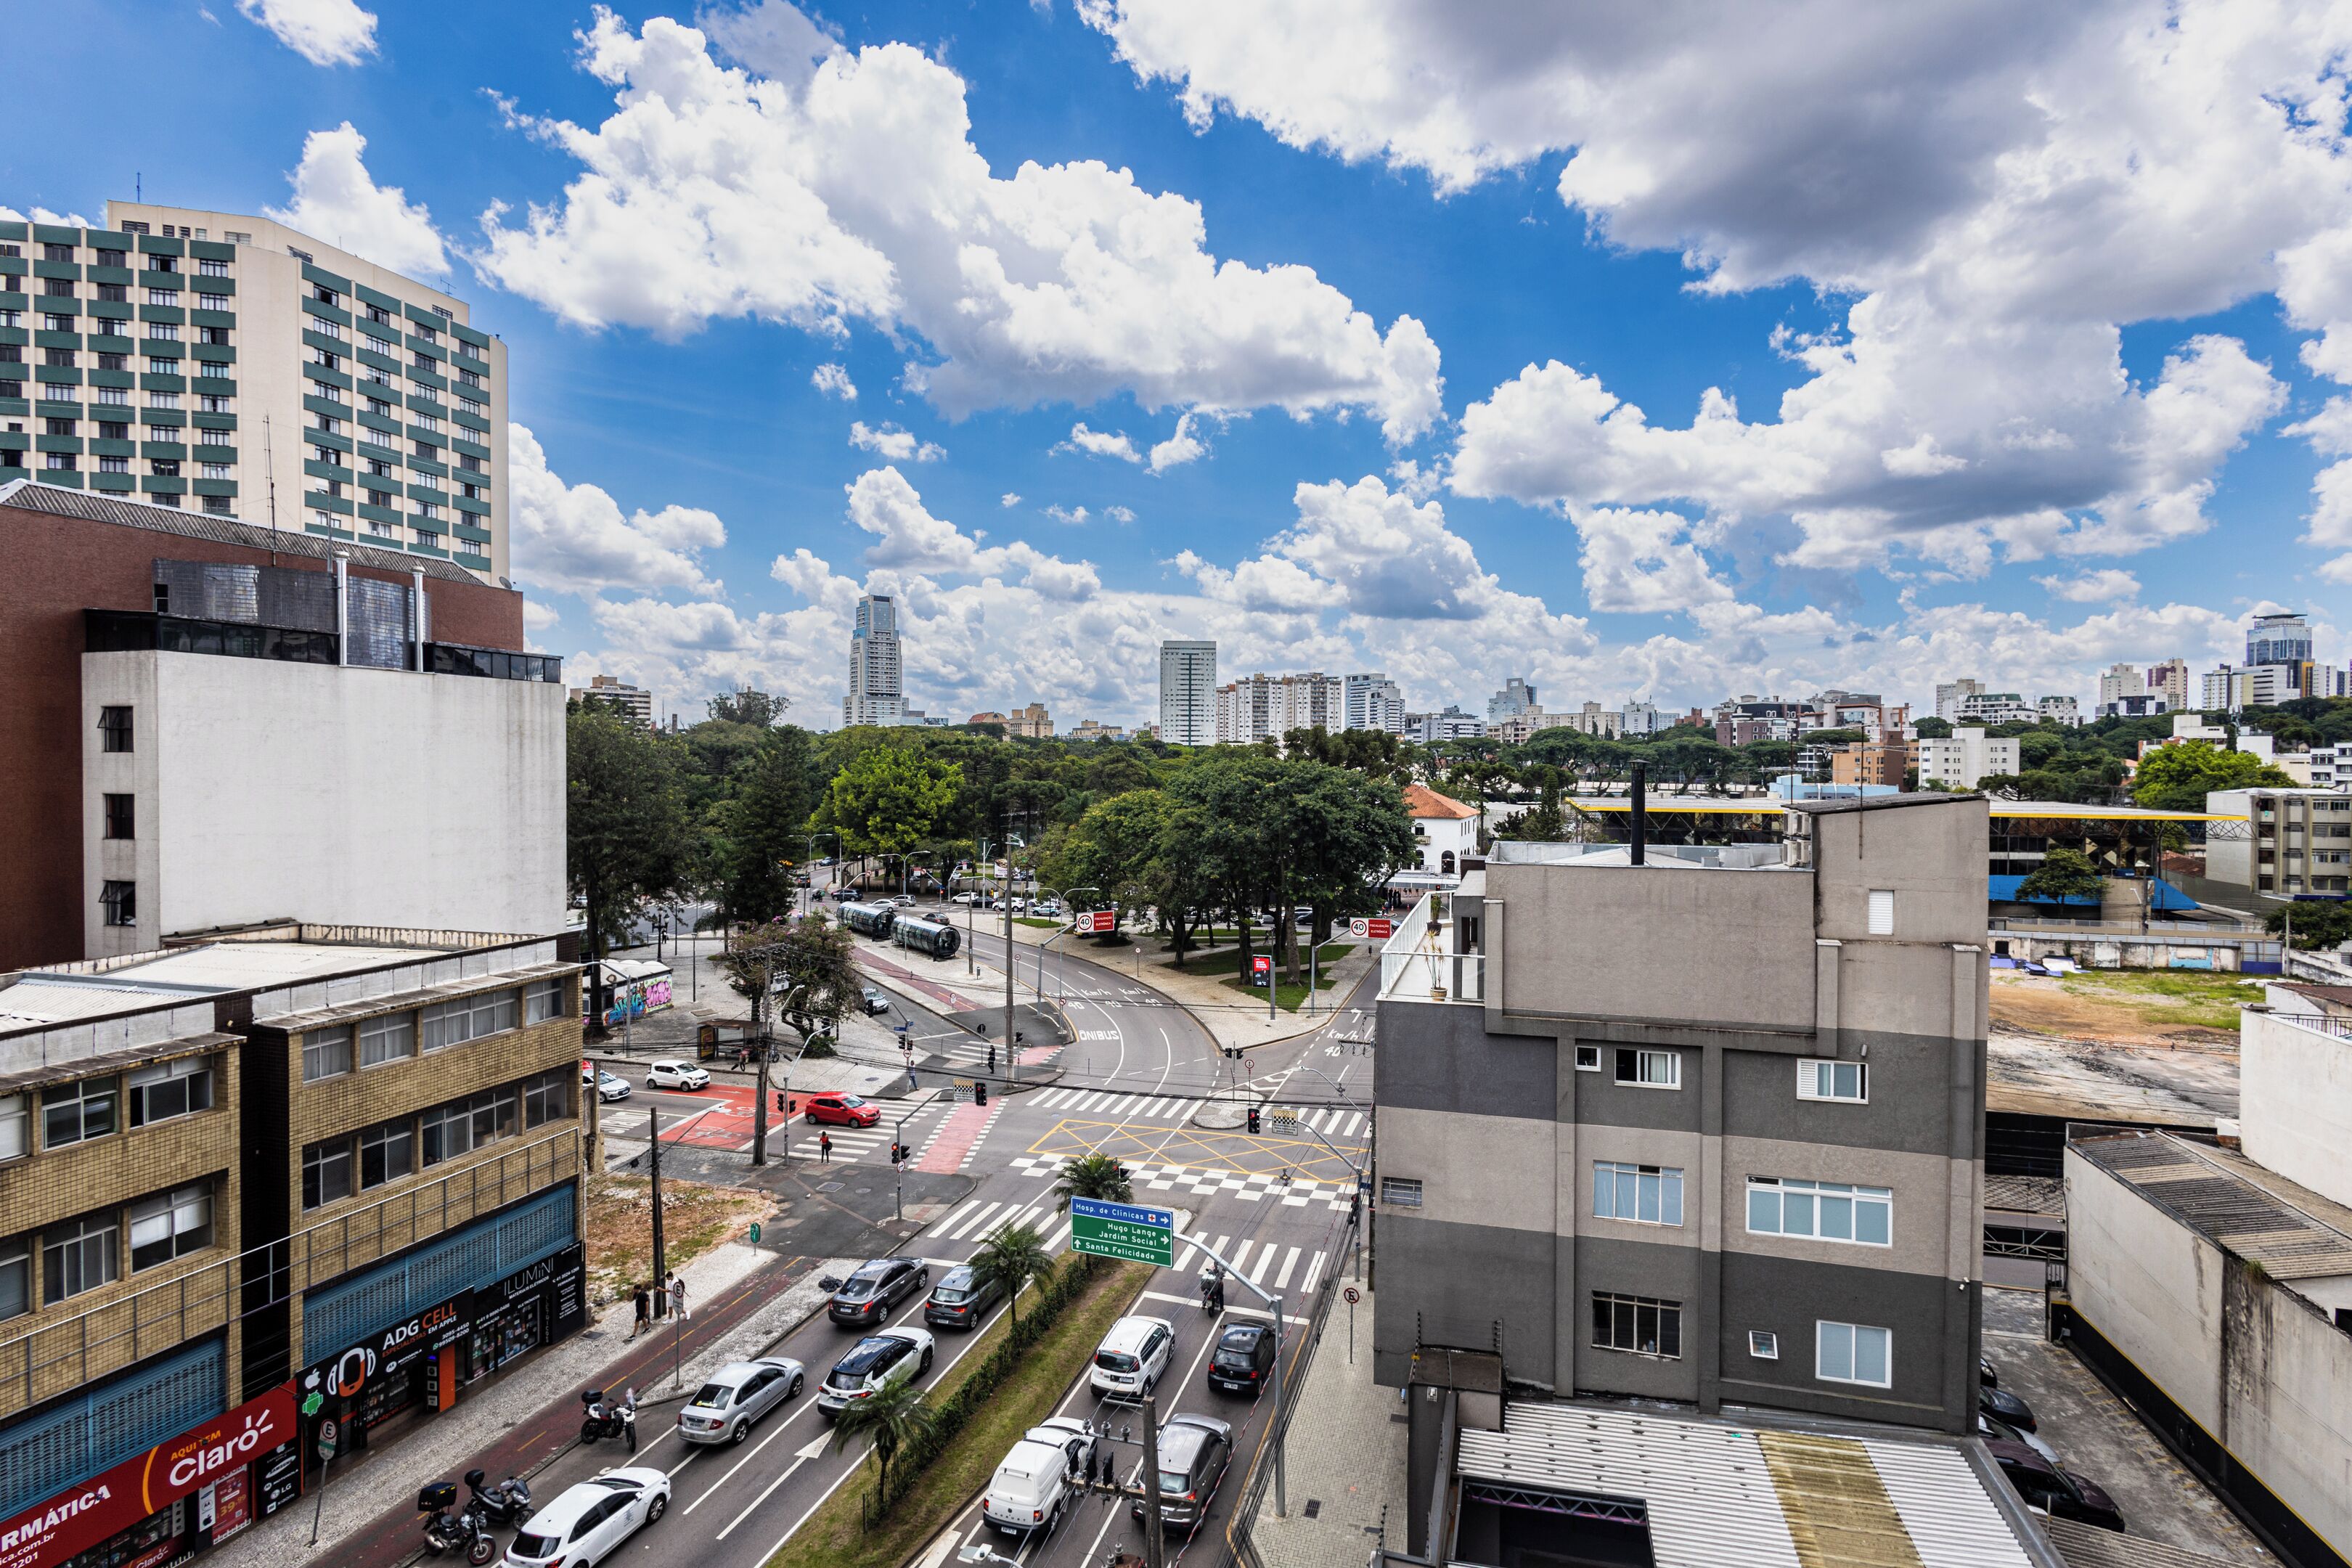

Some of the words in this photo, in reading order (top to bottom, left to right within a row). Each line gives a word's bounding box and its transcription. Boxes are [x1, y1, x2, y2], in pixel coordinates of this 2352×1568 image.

[1079, 1029, 1120, 1041] ÔNIBUS
[1076, 1204, 1096, 1213] Hosp.
[1111, 1209, 1144, 1220] Clínicas
[1098, 1231, 1127, 1241] Jardim
[1131, 1236, 1156, 1246] Social
[1108, 1222, 1128, 1233] Hugo
[1132, 1226, 1156, 1238] Lange
[1085, 1242, 1109, 1252] Santa
[1112, 1246, 1155, 1259] Felicidade
[509, 1287, 528, 1299] MATERIAIS
[529, 1275, 550, 1289] ELÉTRICOS
[676, 1285, 681, 1295] E
[1348, 1291, 1355, 1301] E
[383, 1320, 419, 1350] ADG
[422, 1302, 457, 1329] CELL
[441, 1322, 470, 1340] 3095-4450
[382, 1331, 427, 1358] ESPECIALISTAS
[438, 1315, 457, 1328] APPLE
[438, 1328, 470, 1347] 99509-8200
[325, 1423, 333, 1436] E
[170, 1442, 197, 1461] AQUI
[198, 1429, 221, 1445] TEM
[169, 1429, 259, 1486] Claro
[281, 1482, 292, 1493] LG
[136, 1551, 165, 1568] Claro
